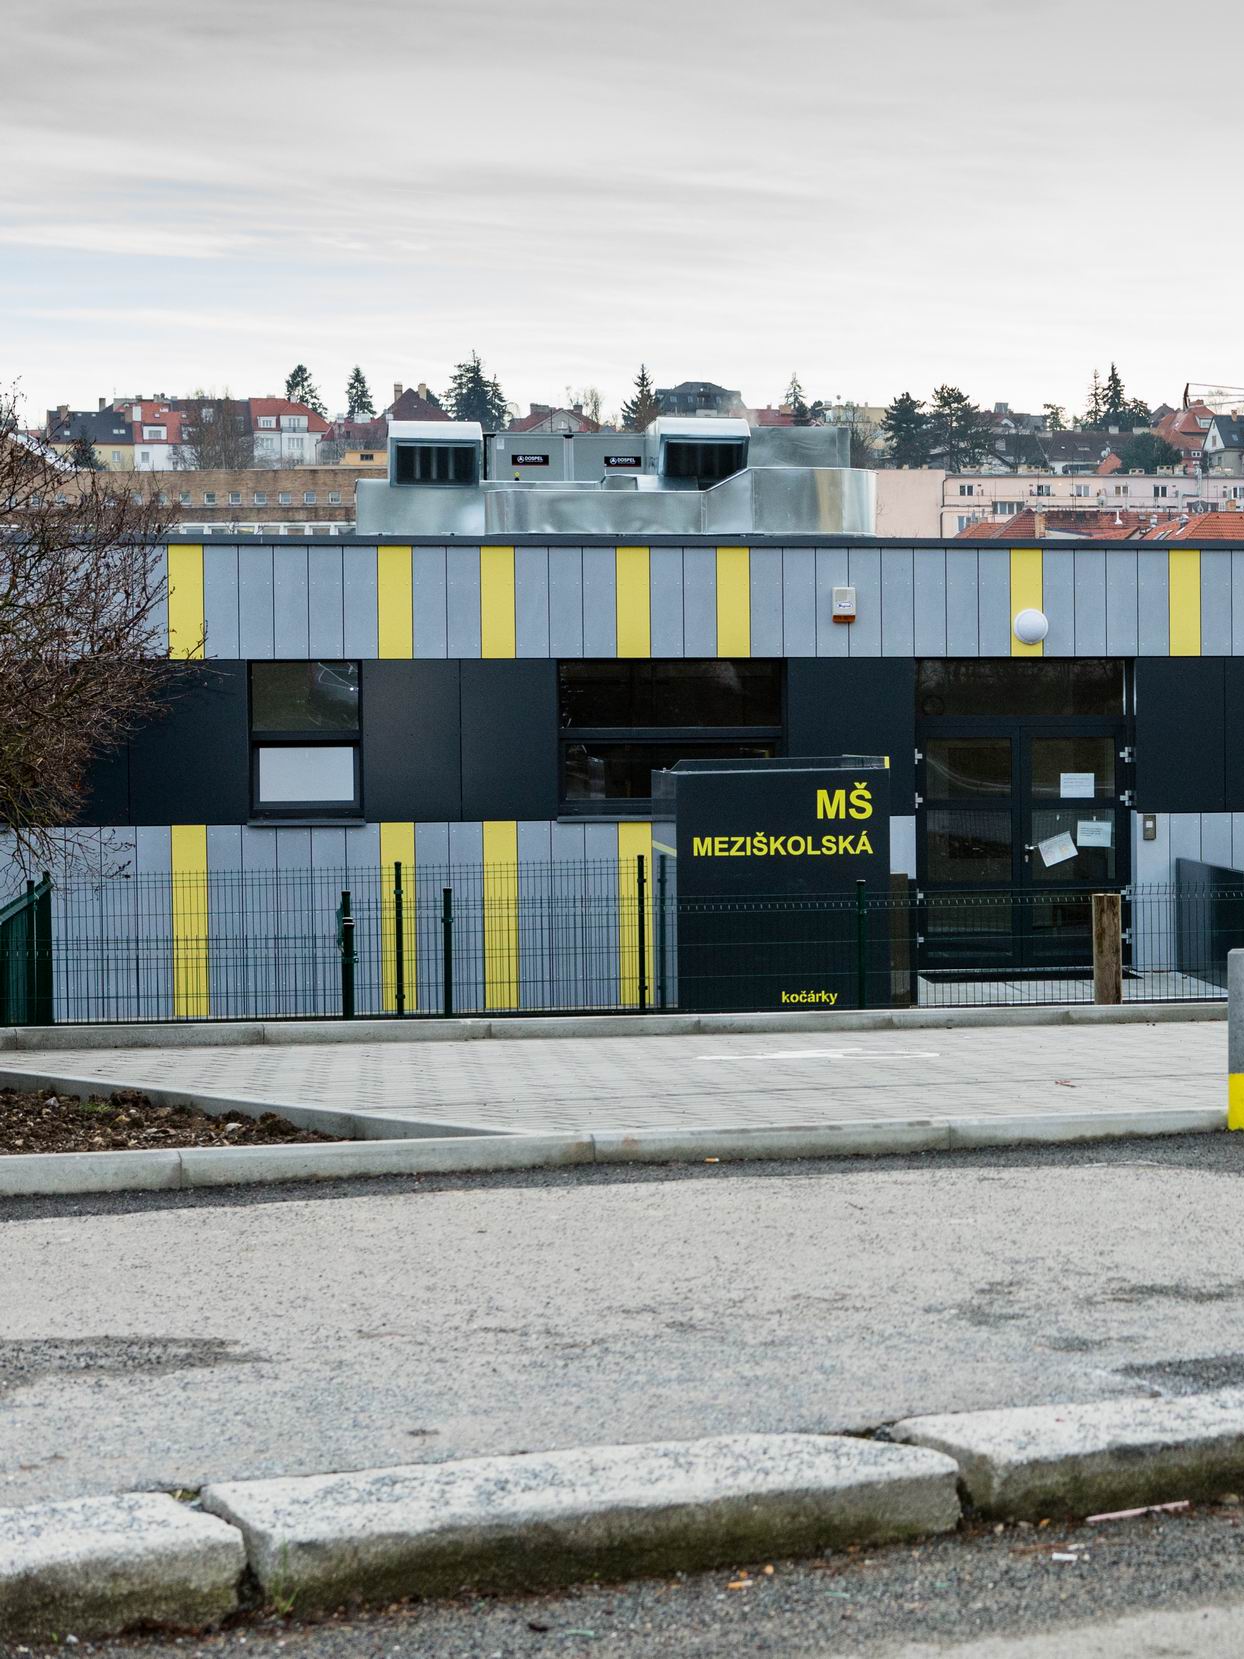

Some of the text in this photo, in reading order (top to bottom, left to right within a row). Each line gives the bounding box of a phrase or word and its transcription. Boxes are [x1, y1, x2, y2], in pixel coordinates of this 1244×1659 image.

[816, 782, 873, 820] MŠ
[693, 831, 874, 857] MEZIŠKOLSKÁ
[781, 990, 838, 1005] kočárky
